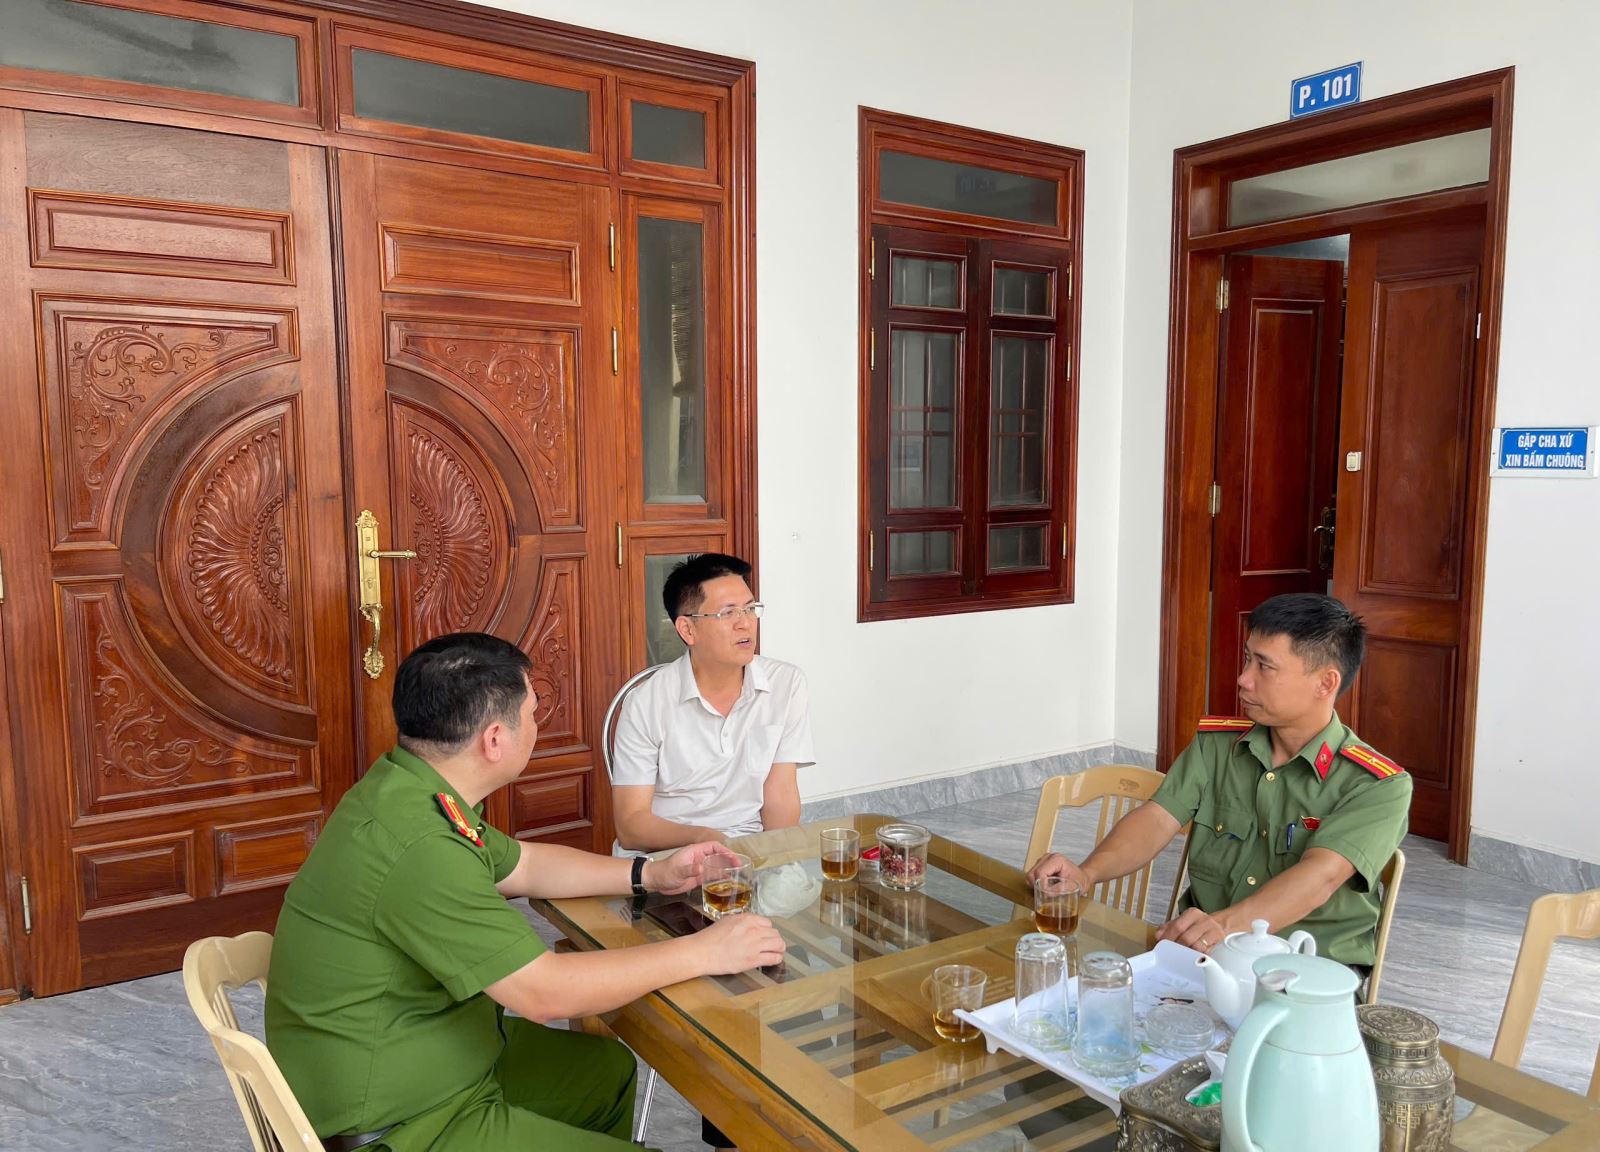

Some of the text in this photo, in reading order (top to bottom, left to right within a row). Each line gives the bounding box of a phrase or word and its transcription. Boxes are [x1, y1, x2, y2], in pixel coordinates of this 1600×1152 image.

[1299, 74, 1352, 108] P. 101
[1518, 432, 1574, 450] GẶP CHA XỨ
[1505, 450, 1584, 467] XIN BẤM CHUÔNG
